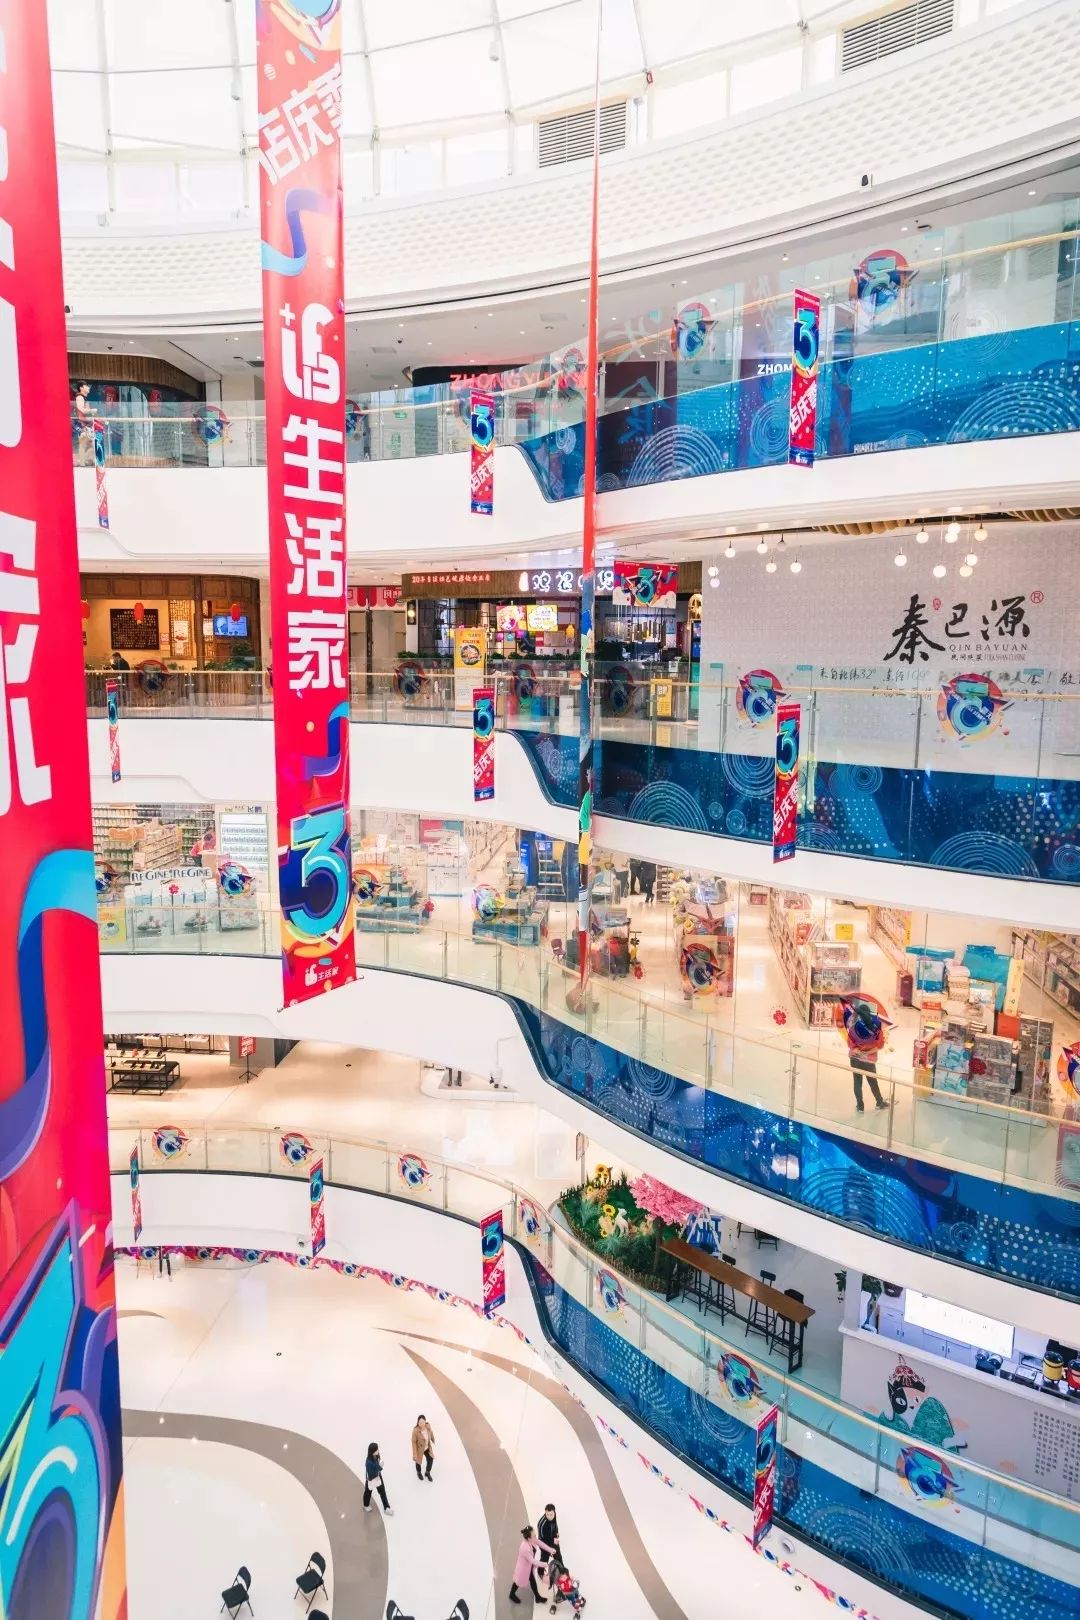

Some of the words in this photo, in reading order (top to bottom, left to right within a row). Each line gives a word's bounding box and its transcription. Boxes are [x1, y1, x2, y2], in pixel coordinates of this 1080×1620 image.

[283, 414, 345, 690] 生活家
[883, 594, 1030, 664] 秦巴源
[289, 802, 350, 938] 3
